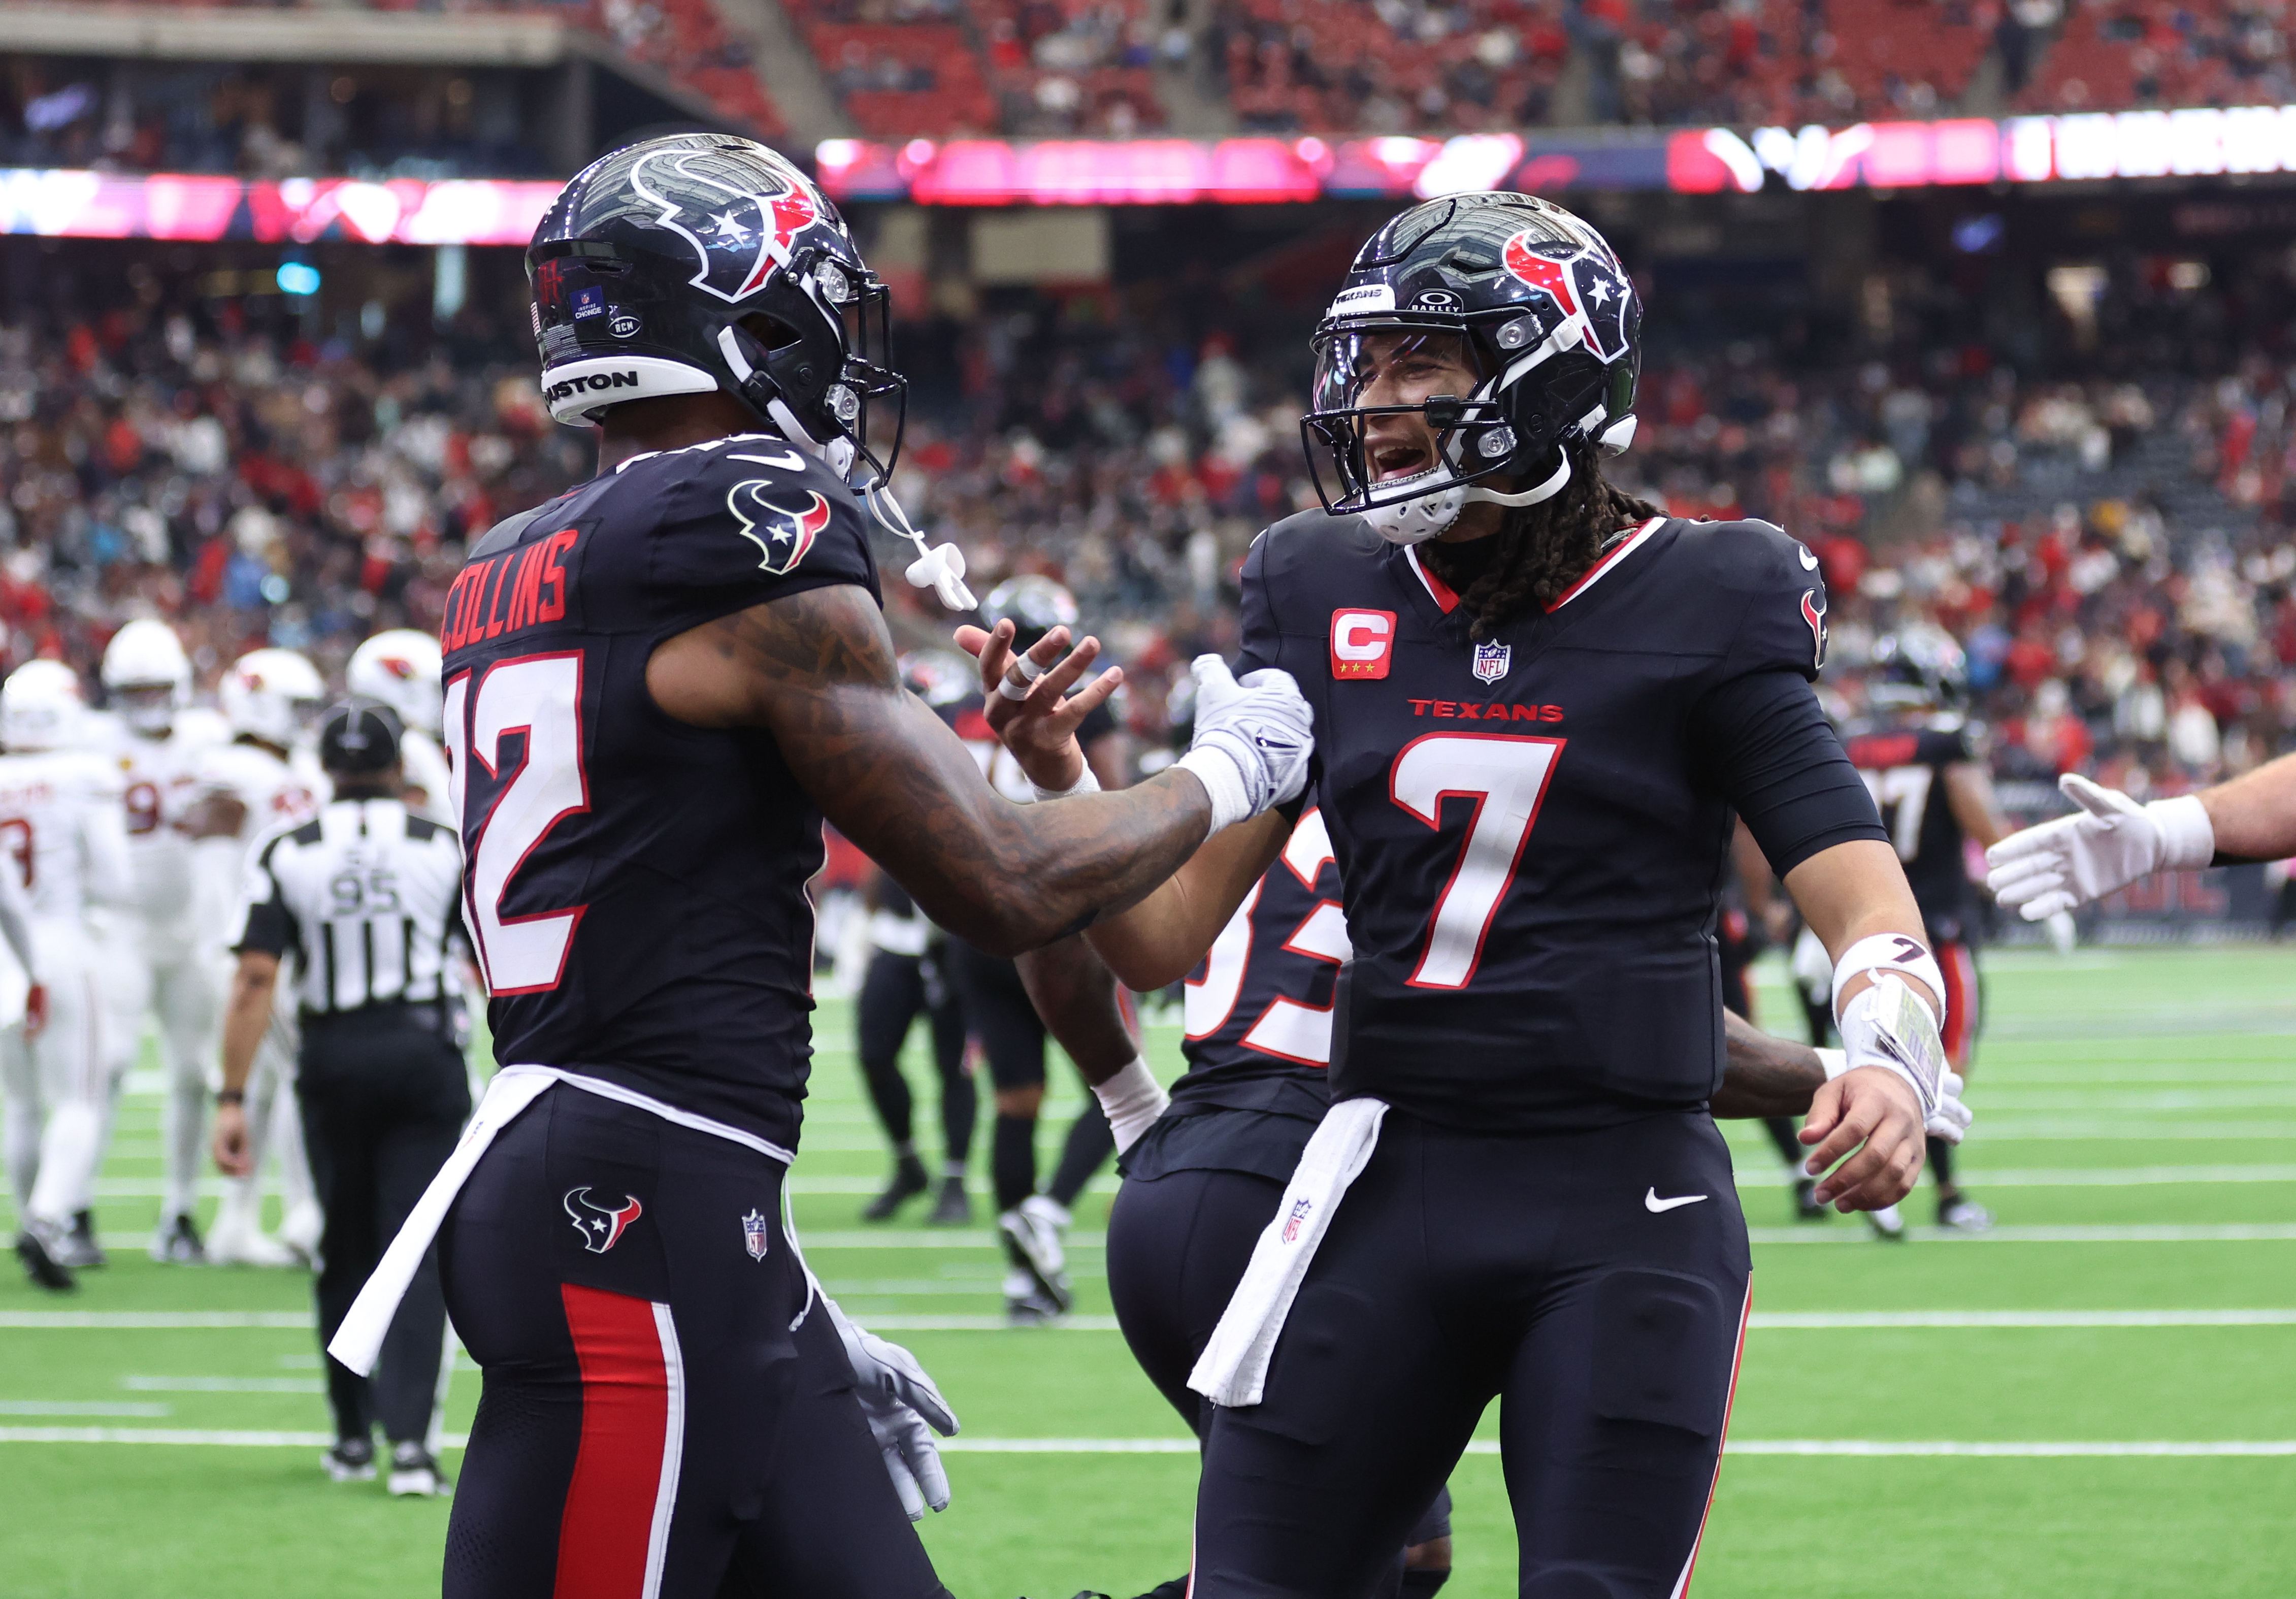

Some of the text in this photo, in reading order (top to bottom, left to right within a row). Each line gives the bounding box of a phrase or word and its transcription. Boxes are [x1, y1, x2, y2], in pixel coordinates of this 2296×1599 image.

[1336, 289, 1382, 304] TEXANS
[575, 307, 602, 319] CHANGE
[615, 321, 633, 333] RCM
[441, 529, 579, 658] COLLINS
[1334, 613, 1389, 660] C
[1479, 660, 1501, 676] NFL
[1407, 699, 1564, 722] TEXANS
[1389, 731, 1568, 990] 7
[331, 868, 400, 917] 95
[1892, 937, 1926, 963] 7
